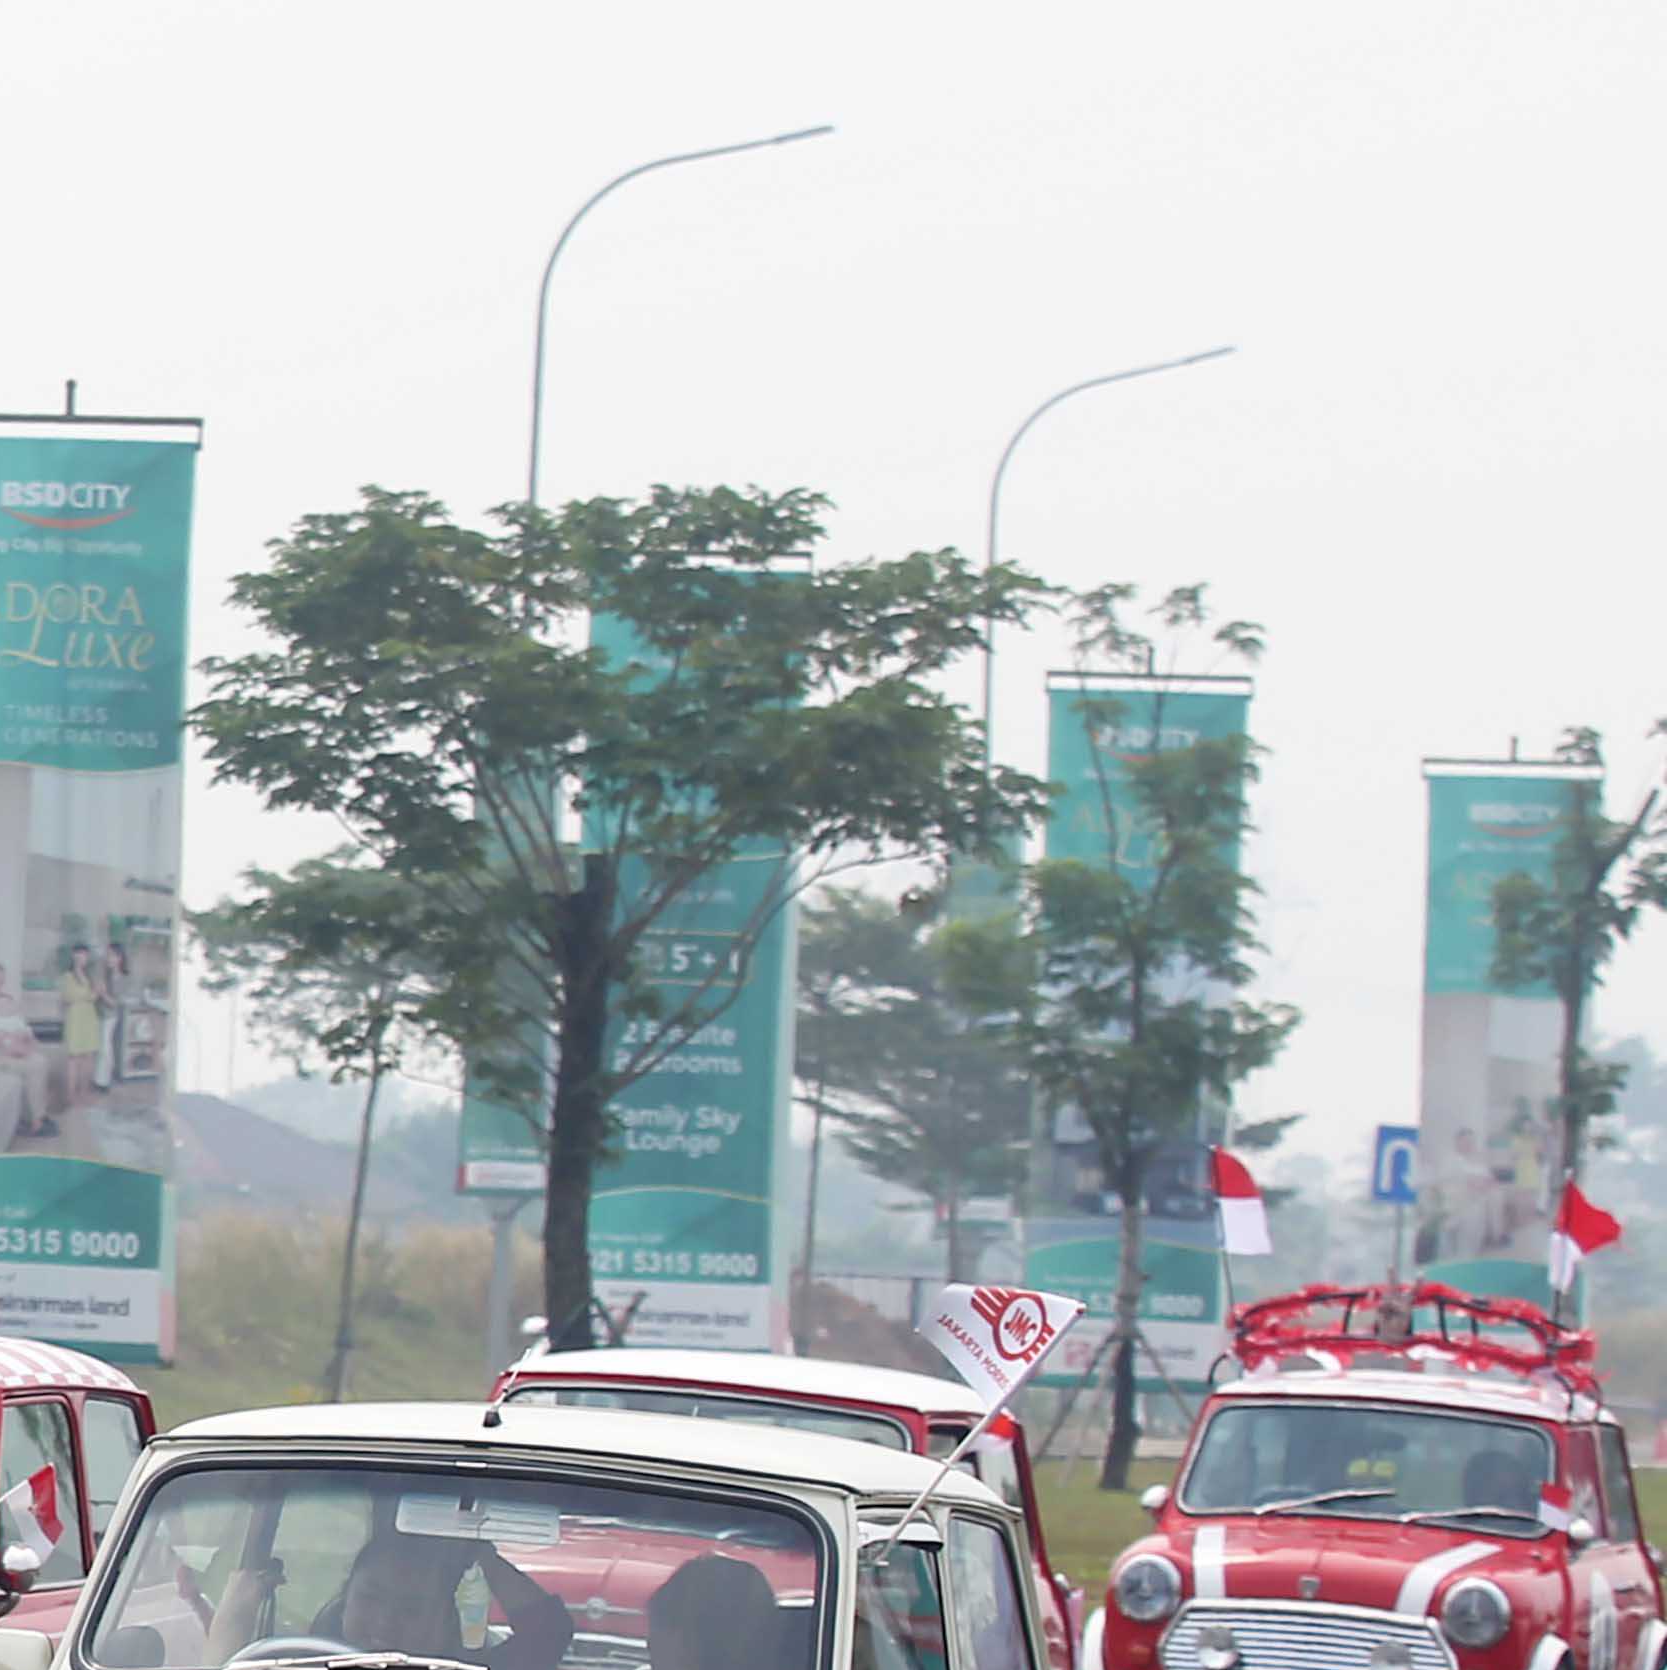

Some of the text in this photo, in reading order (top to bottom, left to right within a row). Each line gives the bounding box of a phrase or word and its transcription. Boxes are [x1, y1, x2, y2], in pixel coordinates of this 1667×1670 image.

[0, 480, 132, 509] BSDCITY
[3, 704, 109, 723] TIMELESS
[697, 1106, 742, 1134] Sky
[625, 1131, 720, 1158] Lounge
[71, 1231, 140, 1259] 9000
[937, 1314, 984, 1363] JAKARTA
[1004, 1307, 1037, 1346] JMC
